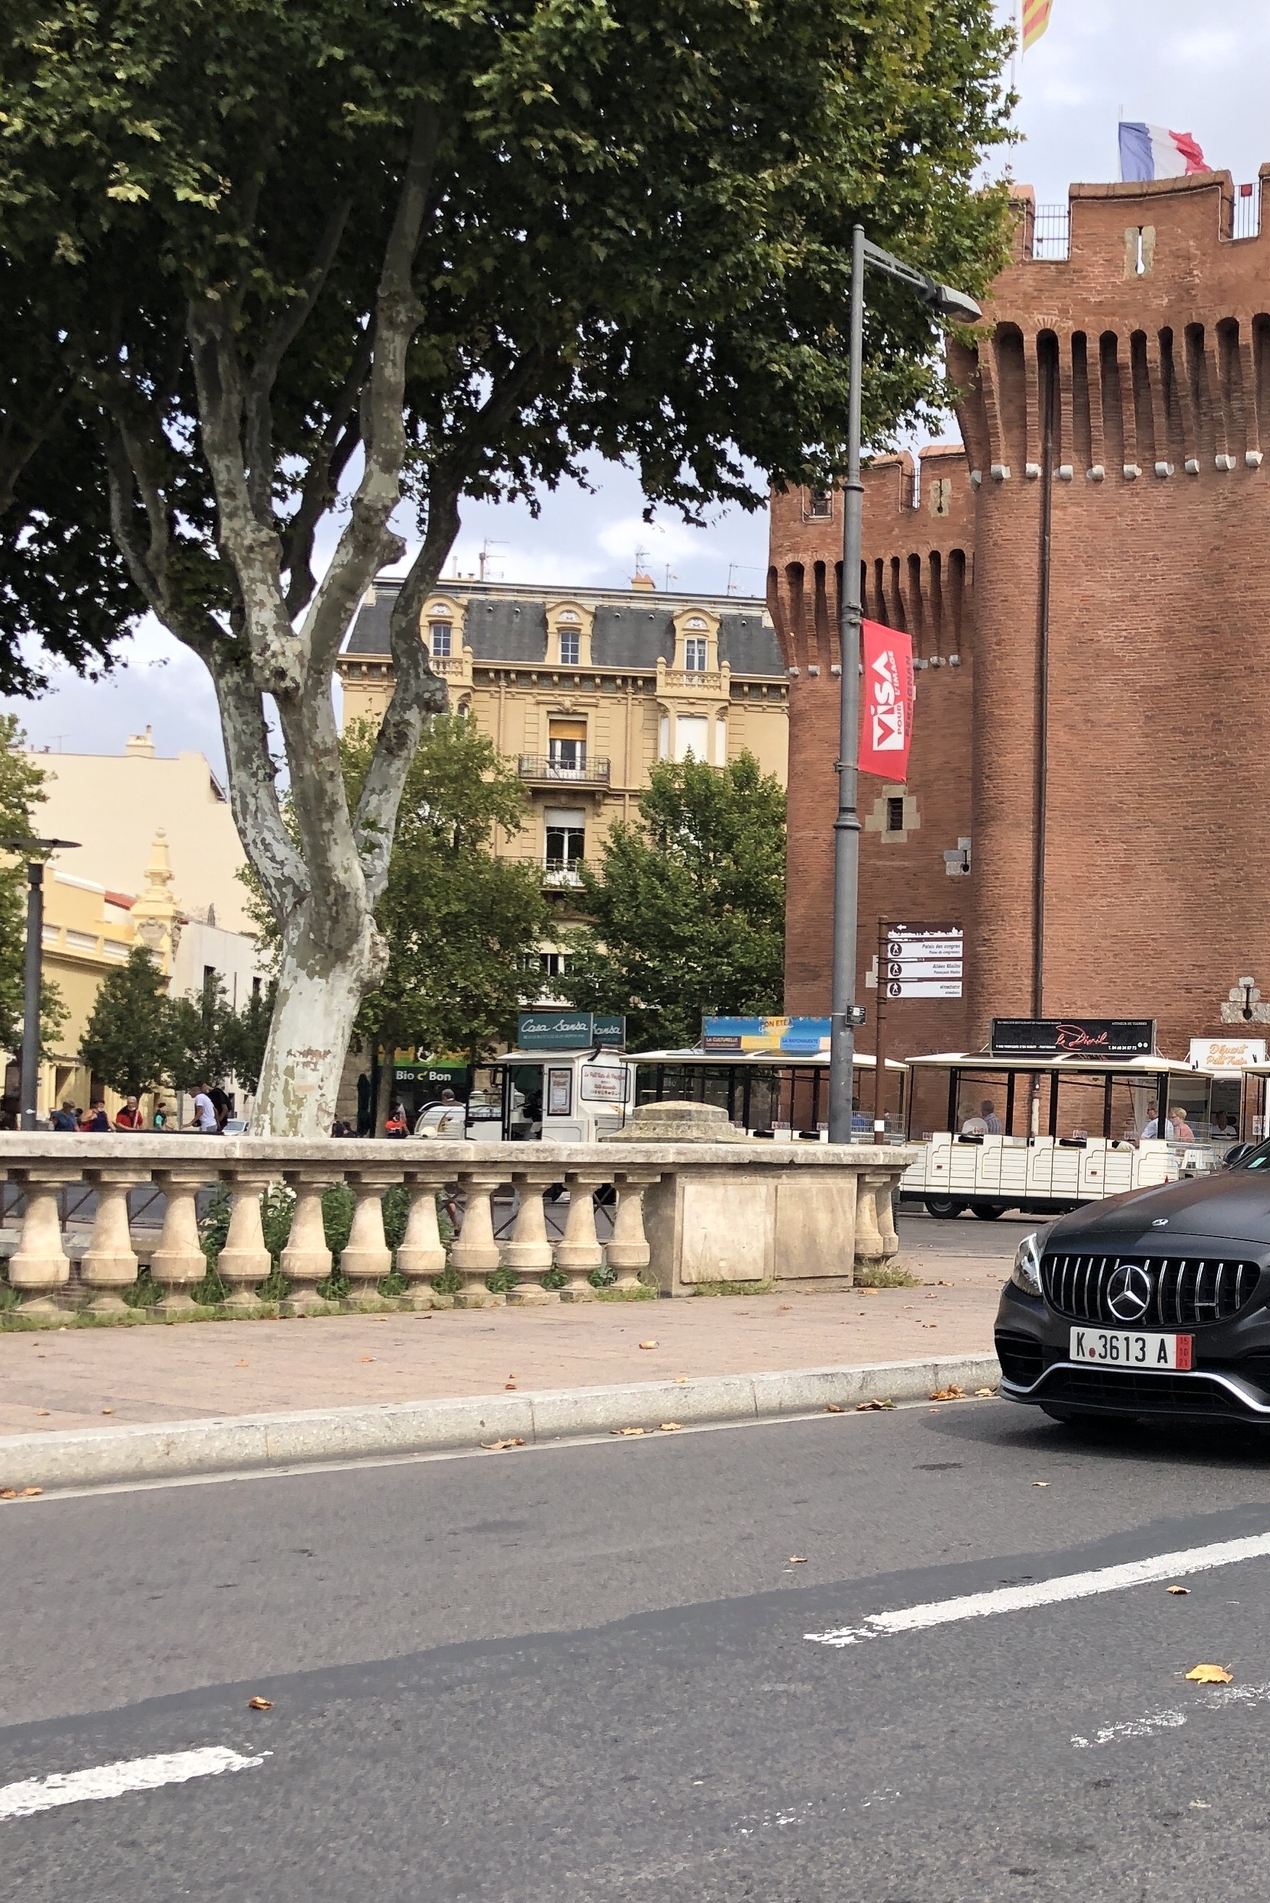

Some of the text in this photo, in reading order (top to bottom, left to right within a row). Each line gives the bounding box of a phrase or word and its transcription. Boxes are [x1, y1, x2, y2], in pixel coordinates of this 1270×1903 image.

[521, 1019, 589, 1032] Casa Sansa
[396, 1070, 415, 1080] Bio
[429, 1071, 452, 1081] Bon
[1076, 1332, 1169, 1364] K 3613 A
